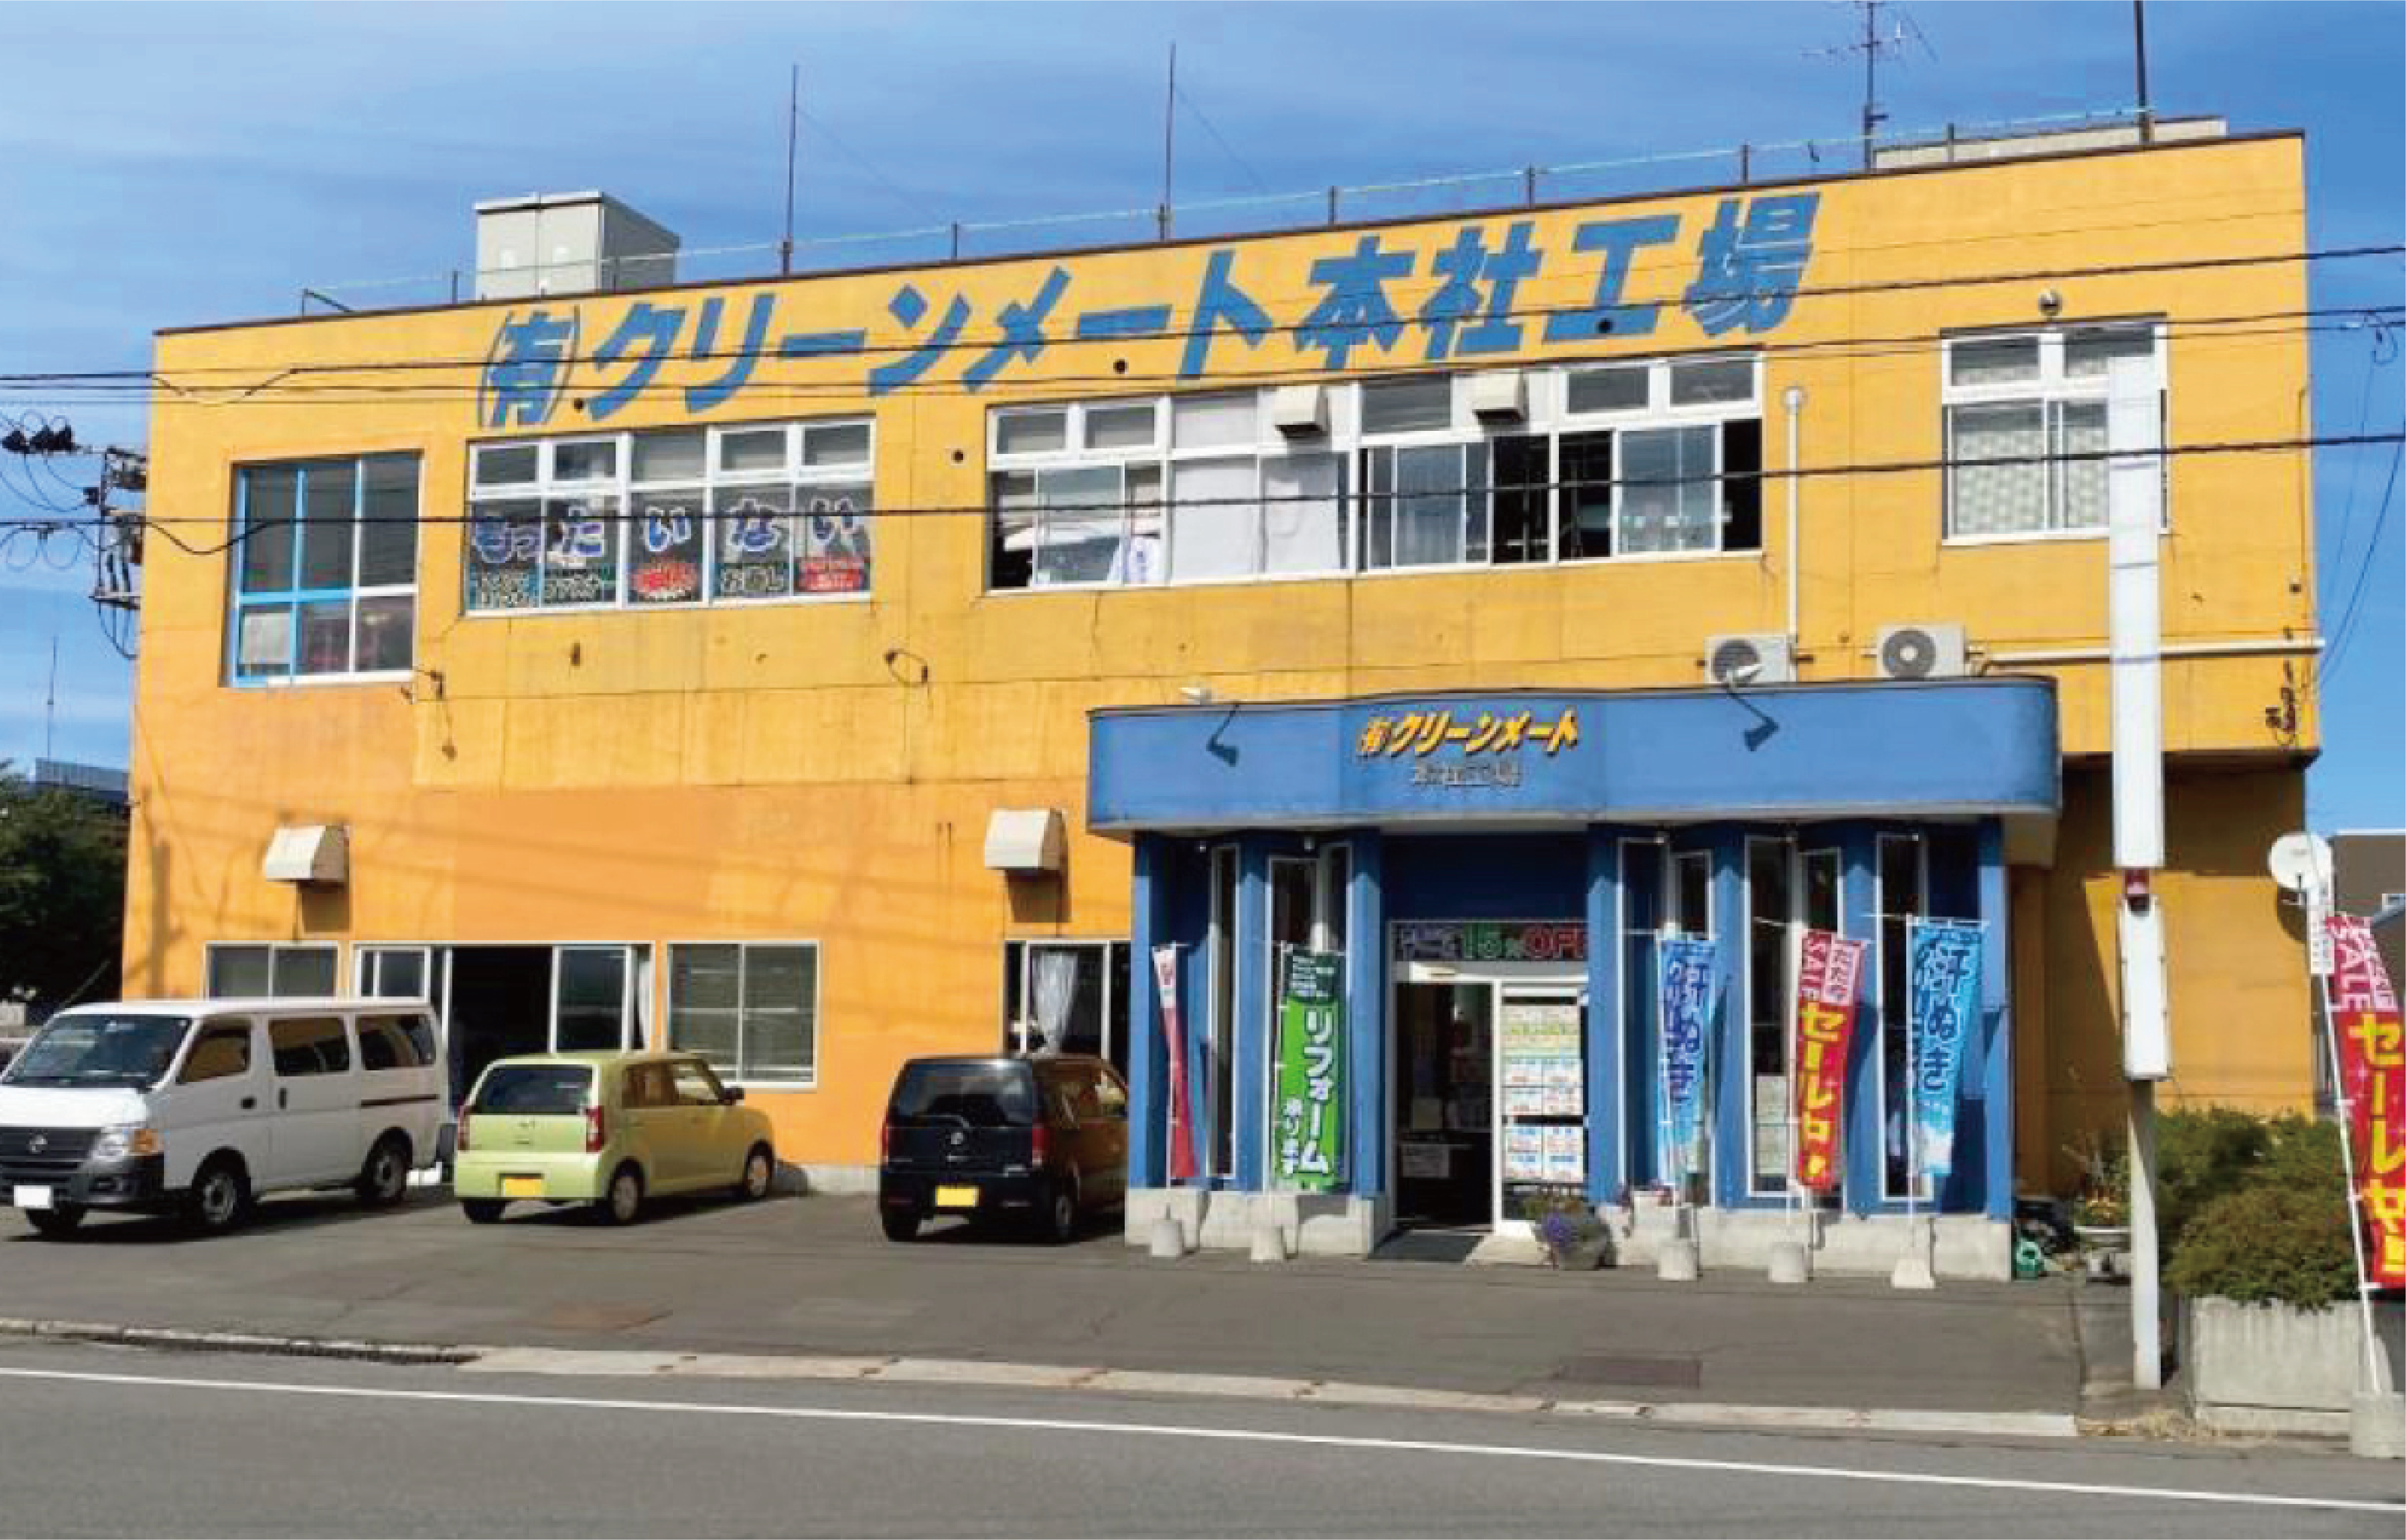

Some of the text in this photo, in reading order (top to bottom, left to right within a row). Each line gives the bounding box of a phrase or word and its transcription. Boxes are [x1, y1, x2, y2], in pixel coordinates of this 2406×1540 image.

[1301, 1009, 1334, 1174] リフォーム
